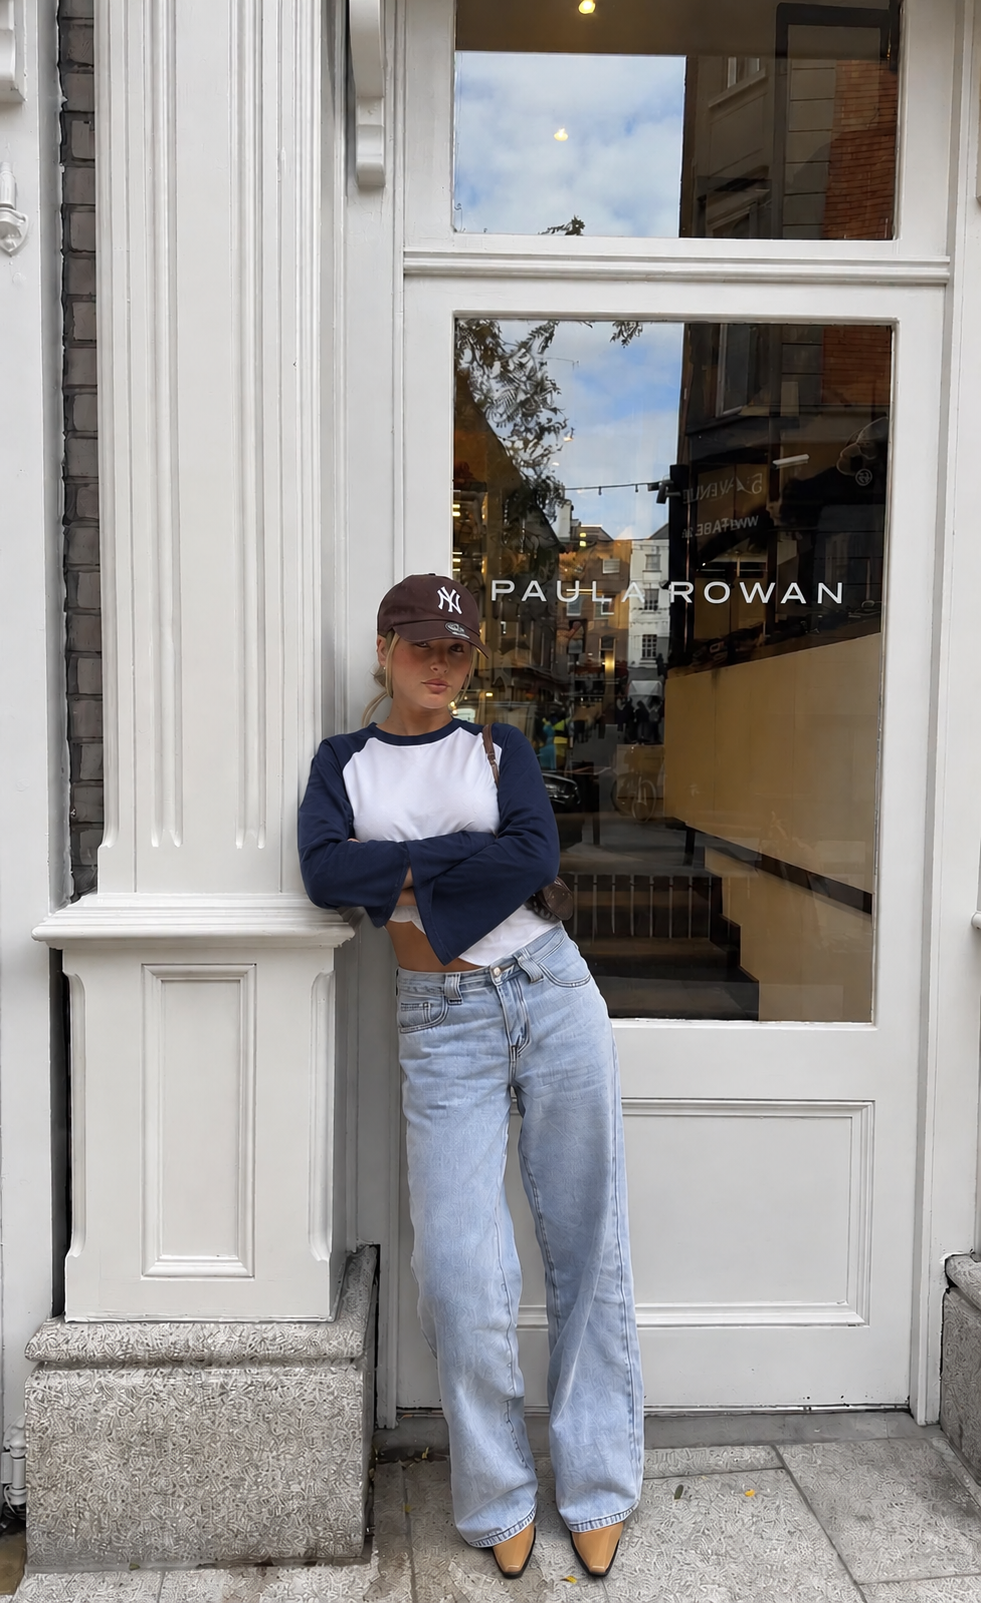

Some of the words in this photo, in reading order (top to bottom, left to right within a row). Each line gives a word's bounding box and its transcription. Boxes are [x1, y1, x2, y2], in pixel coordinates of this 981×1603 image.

[436, 586, 463, 615] NY
[490, 579, 646, 604] PAULA
[669, 581, 844, 604] ROWAN
